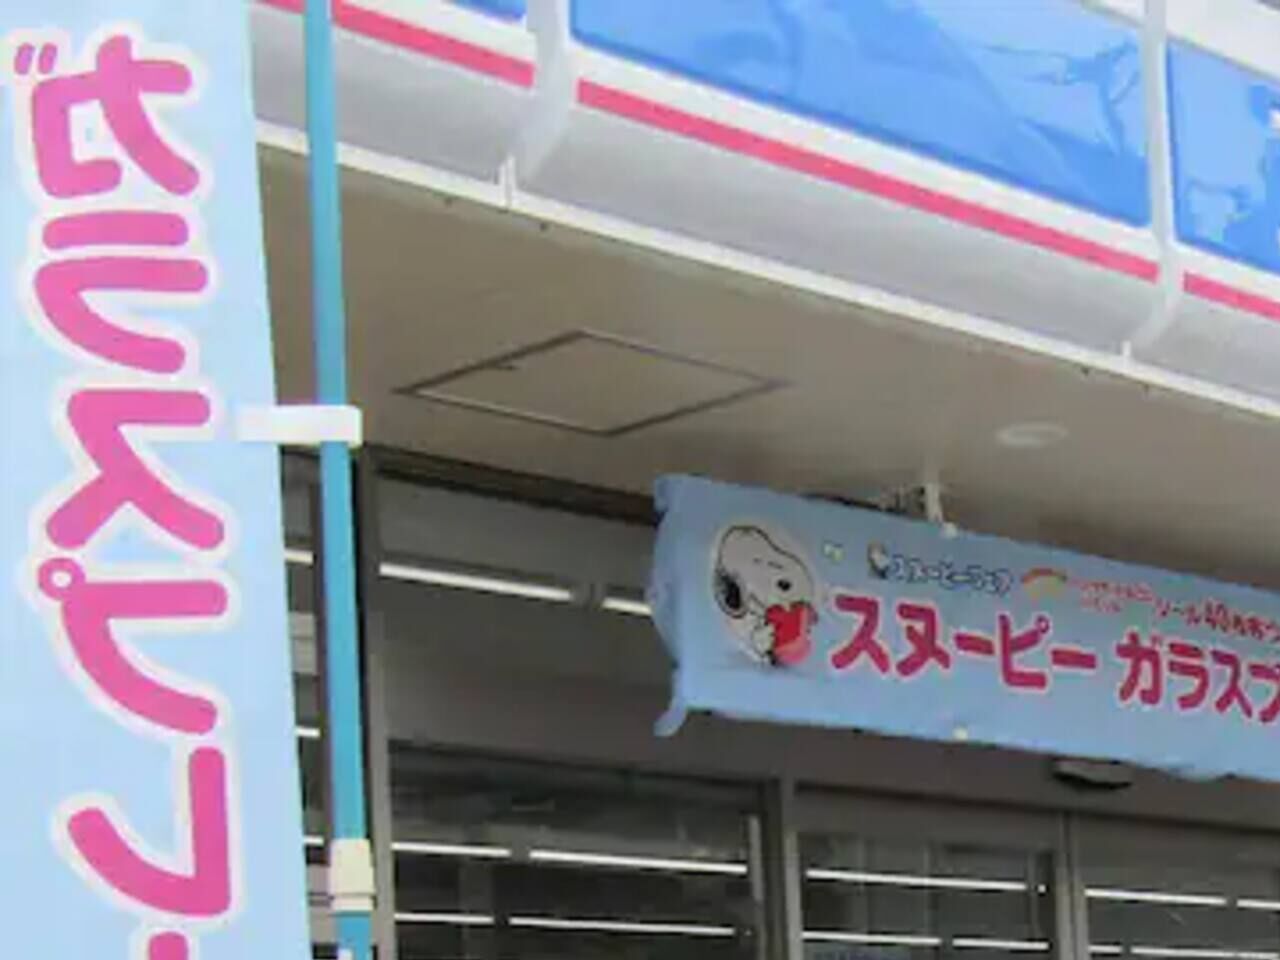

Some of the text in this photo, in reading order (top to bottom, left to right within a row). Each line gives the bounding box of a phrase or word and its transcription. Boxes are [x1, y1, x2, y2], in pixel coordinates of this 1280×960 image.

[831, 594, 1096, 688] スヌーピー
